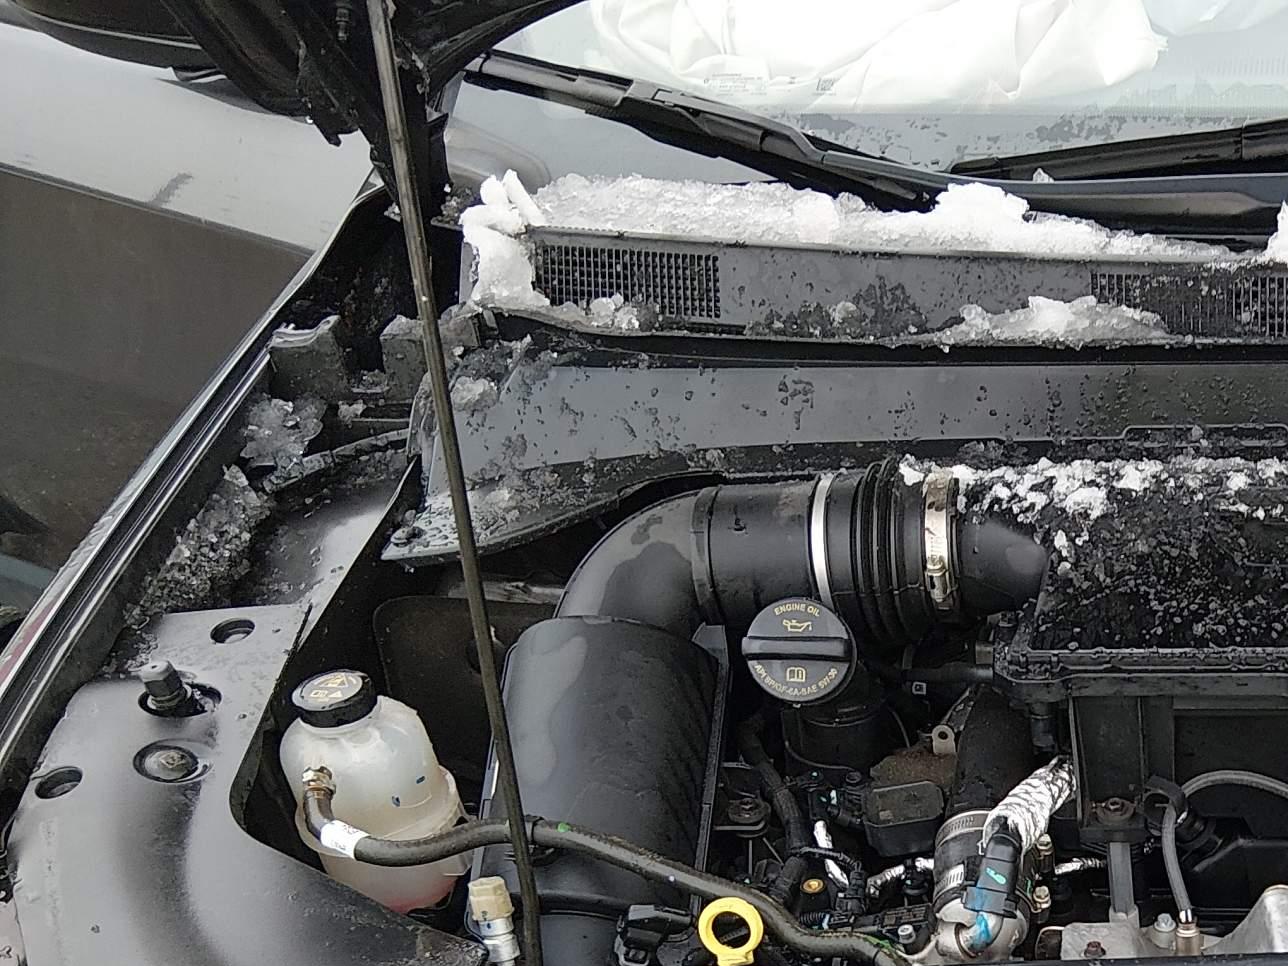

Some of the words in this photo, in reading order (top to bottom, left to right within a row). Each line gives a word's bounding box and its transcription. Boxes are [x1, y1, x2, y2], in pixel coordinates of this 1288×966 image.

[774, 603, 806, 616] ENGINE
[807, 605, 820, 617] OIL
[754, 664, 767, 679] API
